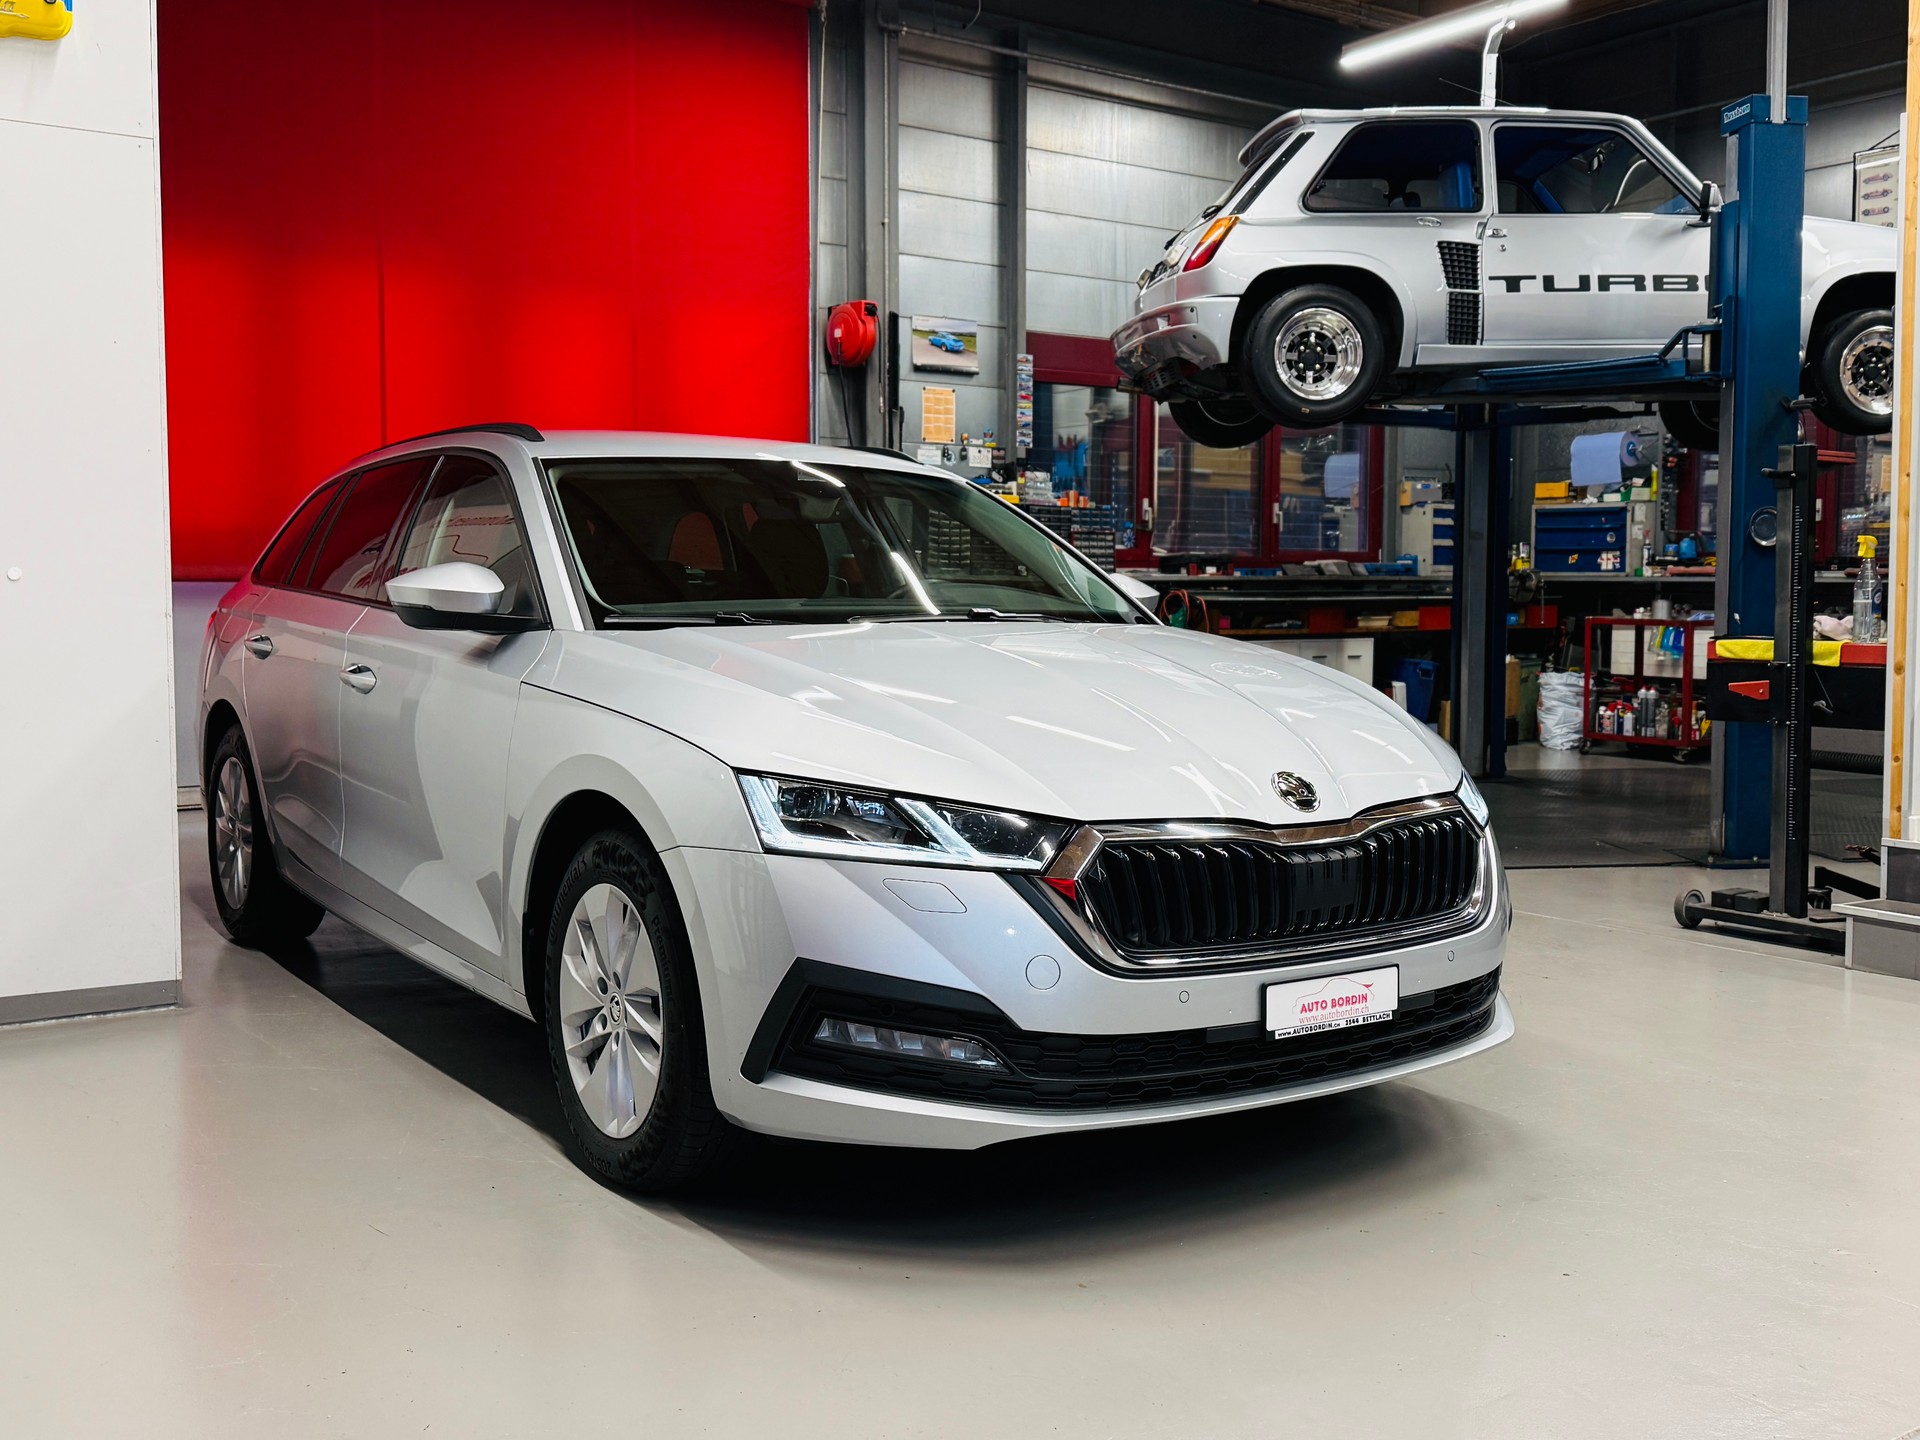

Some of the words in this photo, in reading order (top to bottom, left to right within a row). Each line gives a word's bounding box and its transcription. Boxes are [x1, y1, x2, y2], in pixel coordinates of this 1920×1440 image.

[1488, 274, 1709, 293] TURB
[1300, 999, 1328, 1014] AUTO
[1330, 993, 1368, 1009] BORDIN
[1298, 1004, 1370, 1024] www.autobordin.ch
[1362, 1012, 1391, 1023] BETTLACH
